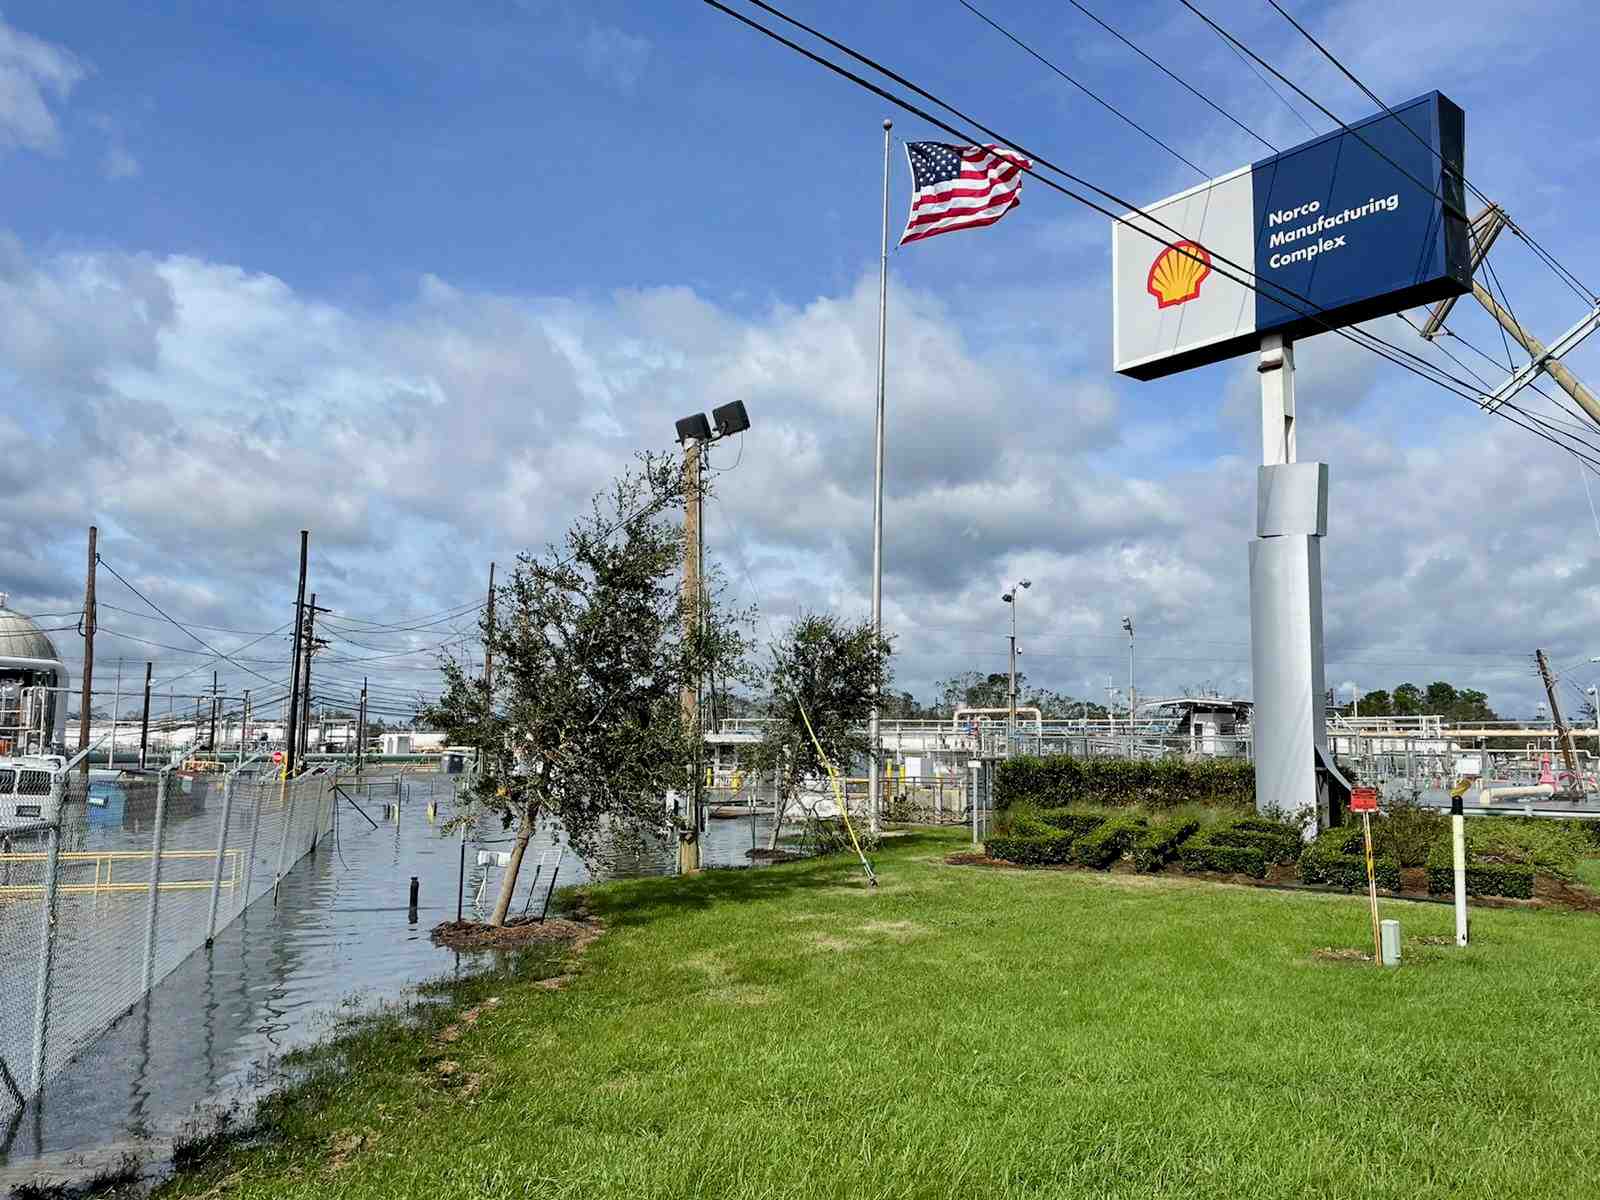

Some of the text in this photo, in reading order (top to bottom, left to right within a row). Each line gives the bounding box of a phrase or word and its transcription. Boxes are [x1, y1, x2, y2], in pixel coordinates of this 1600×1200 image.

[1269, 200, 1321, 227] Norco
[1269, 194, 1399, 248] Manufacturing
[1269, 235, 1347, 269] Complex
